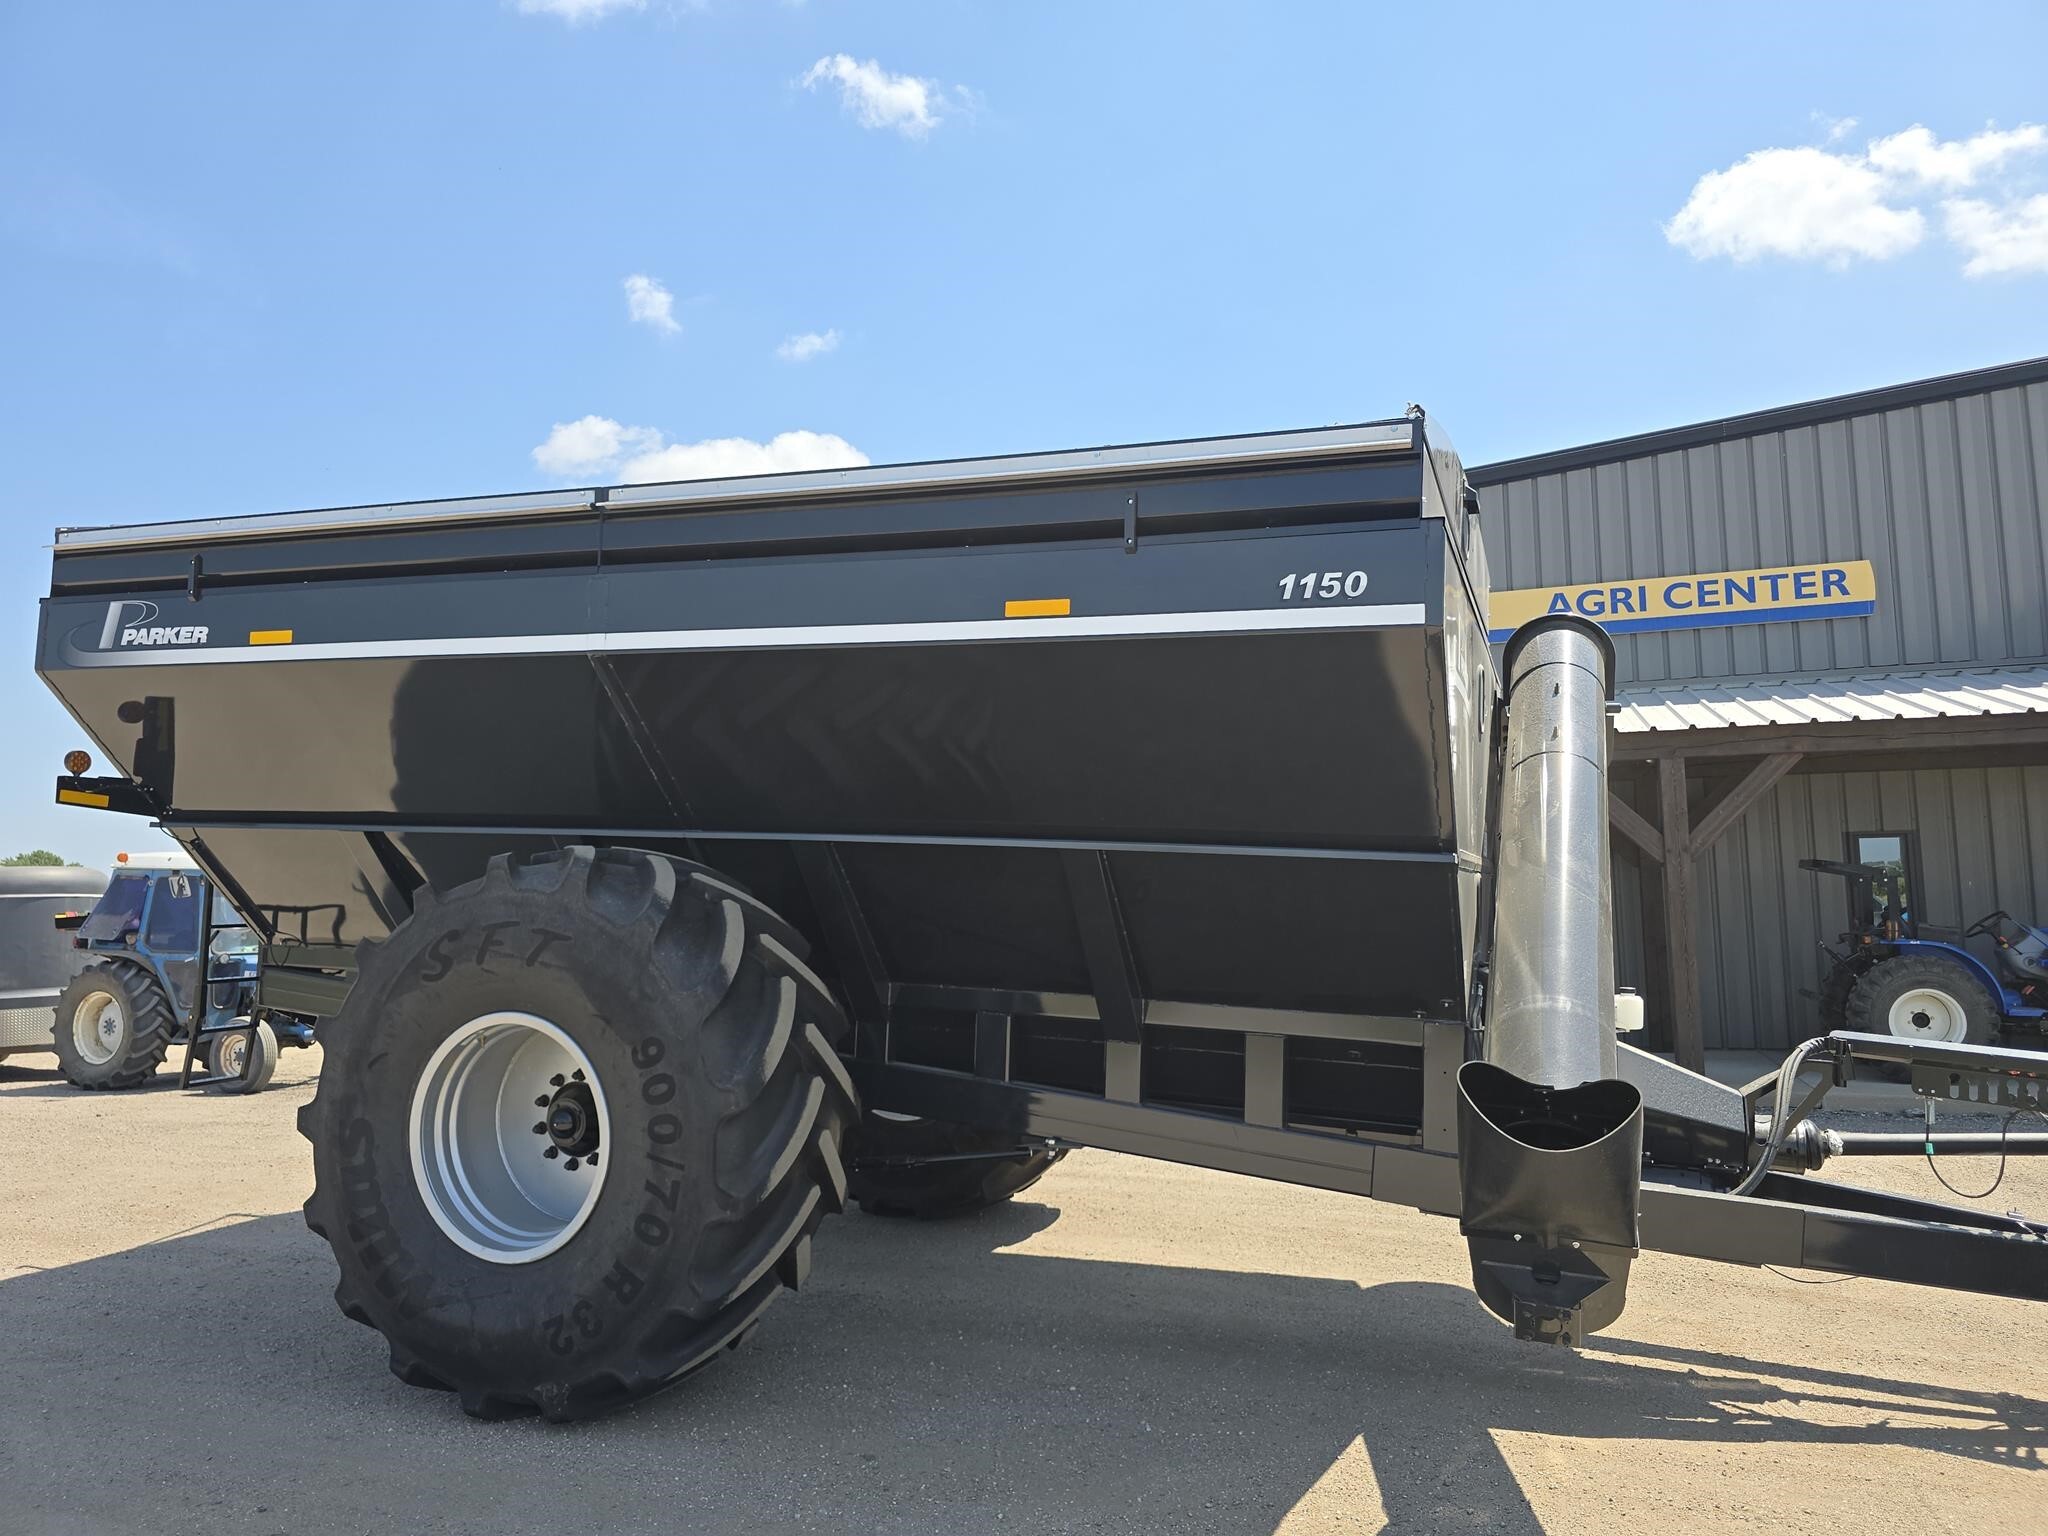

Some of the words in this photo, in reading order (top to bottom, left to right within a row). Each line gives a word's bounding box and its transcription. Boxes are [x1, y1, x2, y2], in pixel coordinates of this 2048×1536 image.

[1279, 570, 1368, 600] 1150
[1547, 585, 1648, 617] AGRI
[1662, 569, 1850, 610] CENTER
[120, 626, 209, 646] PARKER
[421, 920, 574, 983] SFT
[631, 1036, 686, 1248] 900/70
[602, 1258, 645, 1305] R
[541, 1305, 604, 1357] 32
